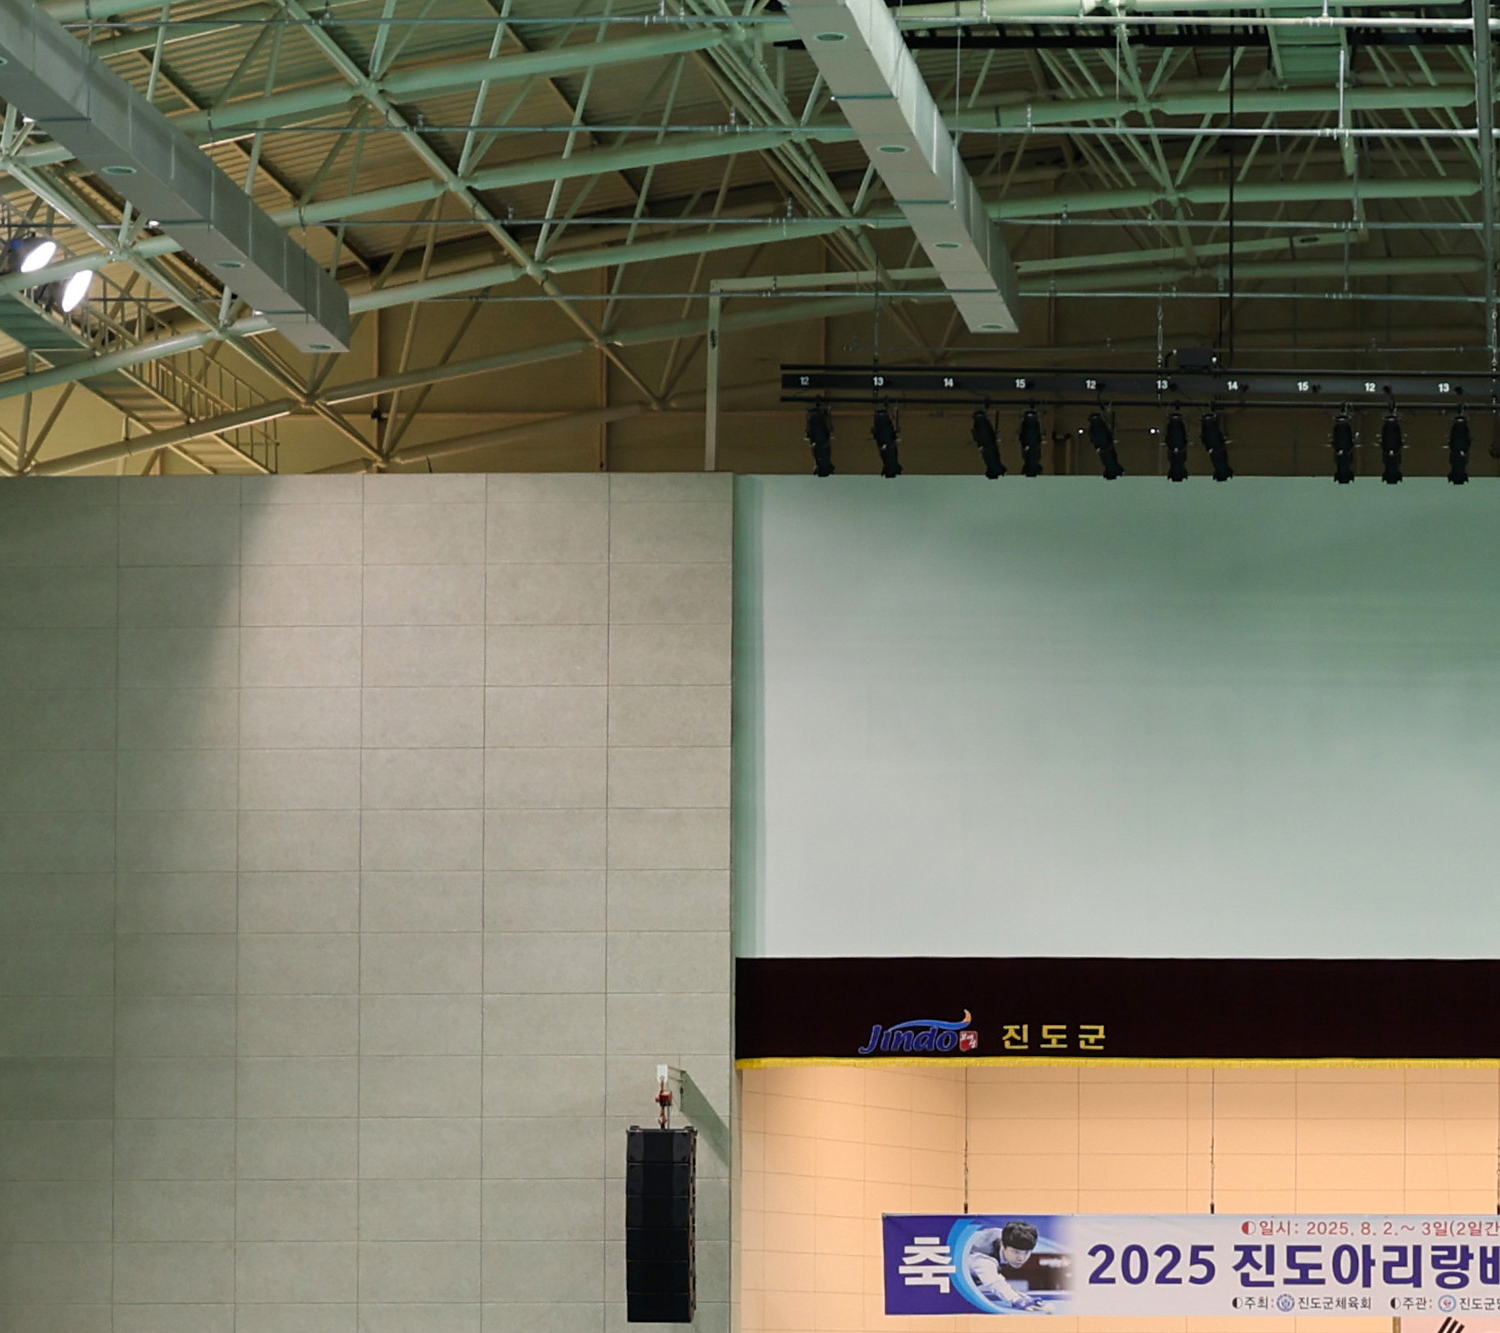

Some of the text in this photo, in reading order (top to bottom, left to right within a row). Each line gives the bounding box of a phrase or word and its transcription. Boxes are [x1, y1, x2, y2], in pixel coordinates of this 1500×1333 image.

[1002, 1023, 1106, 1050] 진도군
[897, 1236, 956, 1294] 축
[1087, 1243, 1216, 1286] 2025
[1297, 1295, 1372, 1311] 진도군체육회
